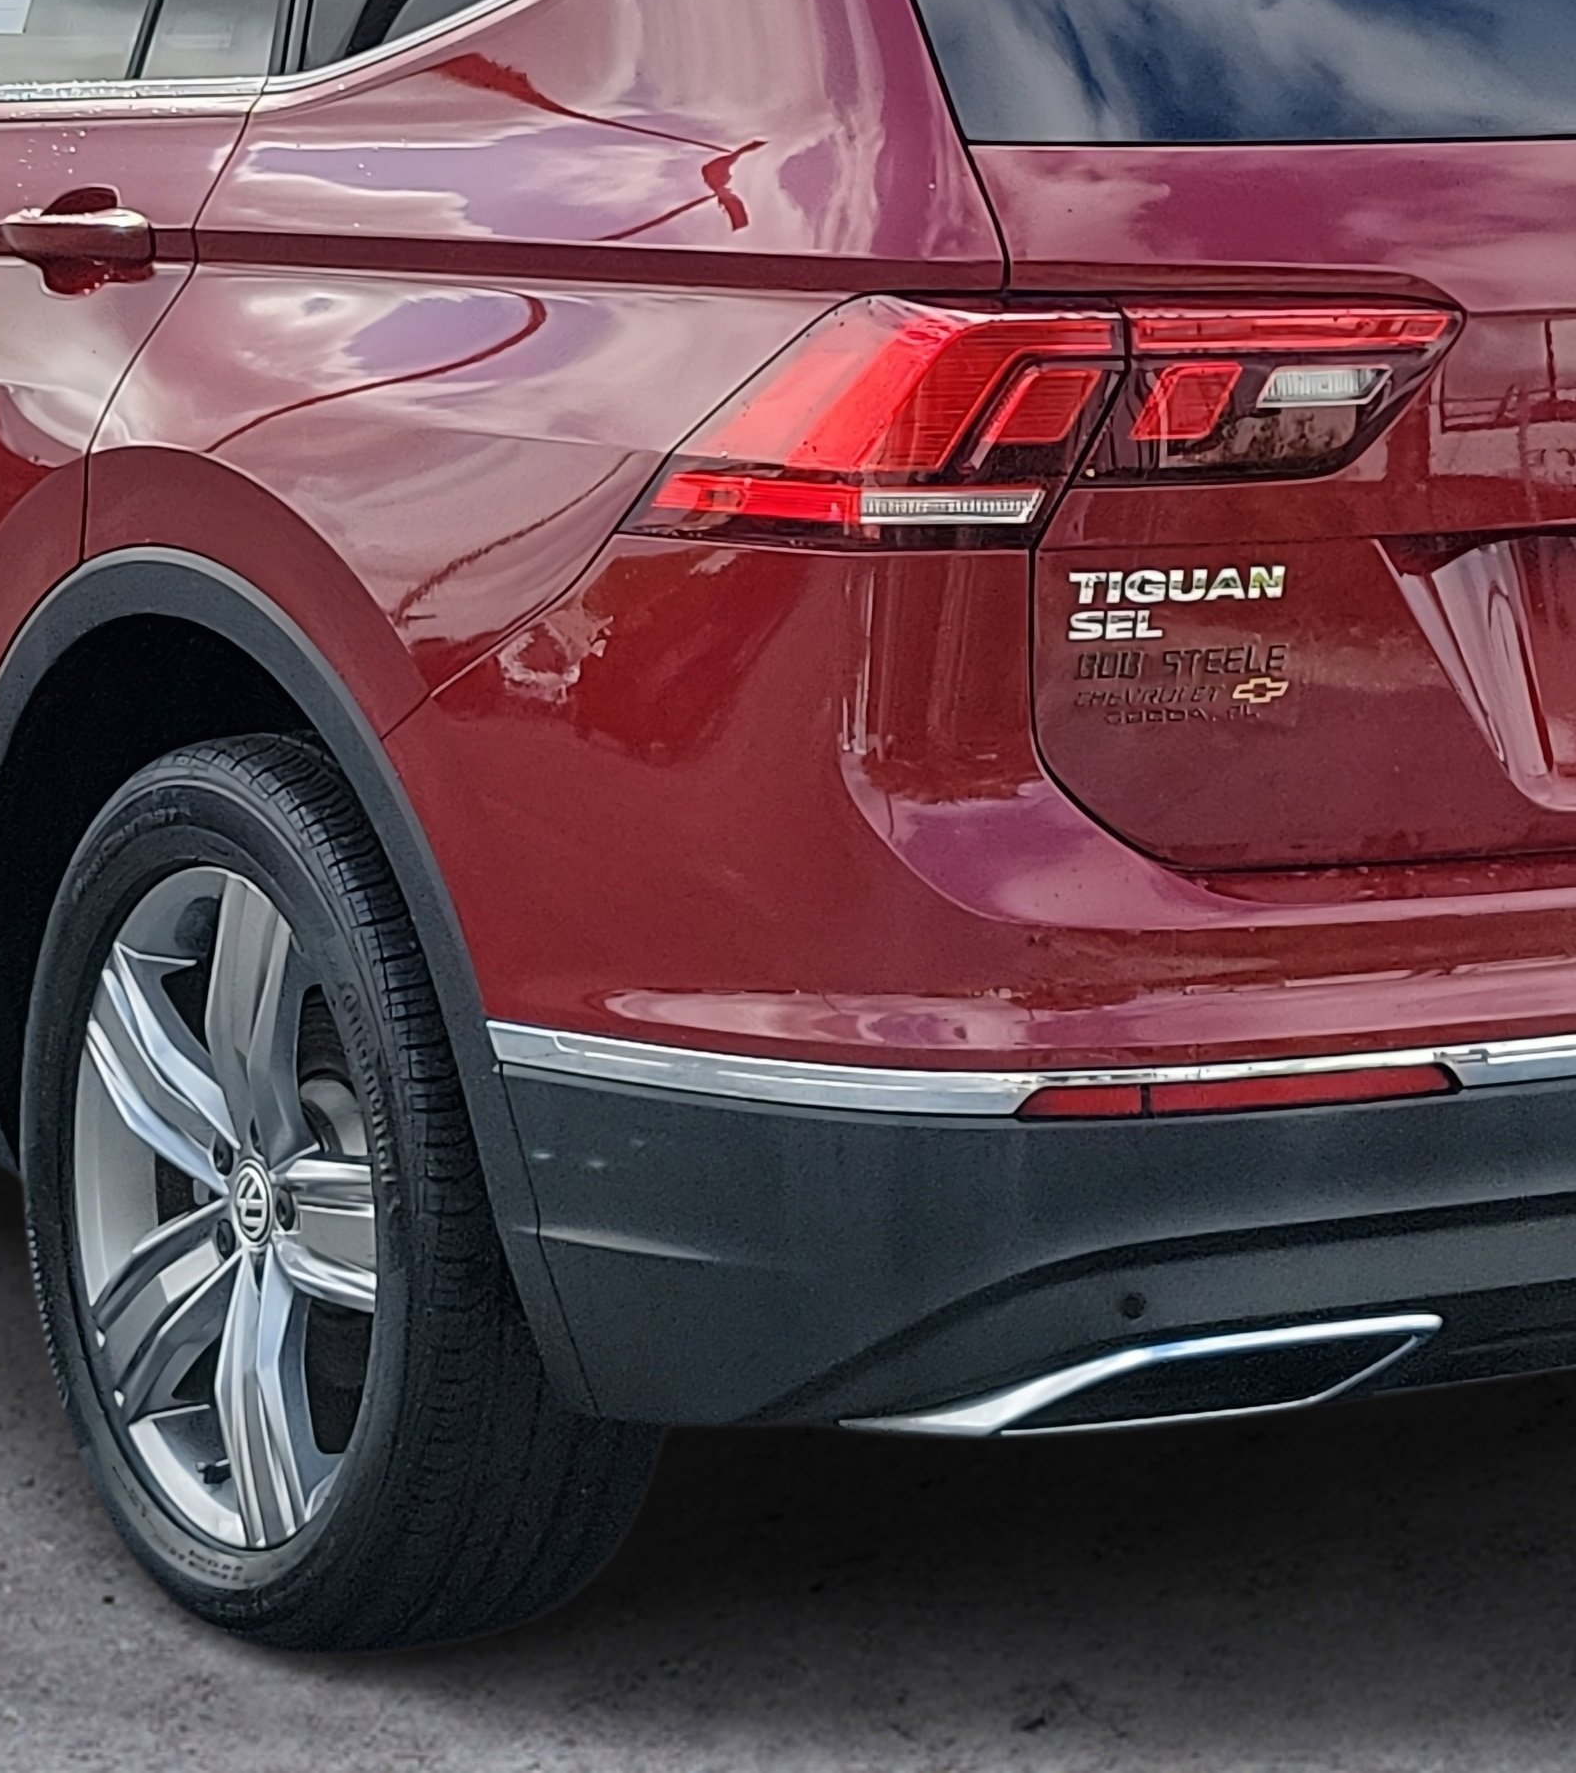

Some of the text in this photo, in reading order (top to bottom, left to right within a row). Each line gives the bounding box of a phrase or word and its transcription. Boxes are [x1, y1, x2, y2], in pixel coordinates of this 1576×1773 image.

[1068, 565, 1286, 605] TIGUAN
[1067, 609, 1163, 641] SEL
[1162, 642, 1289, 677] STEELE
